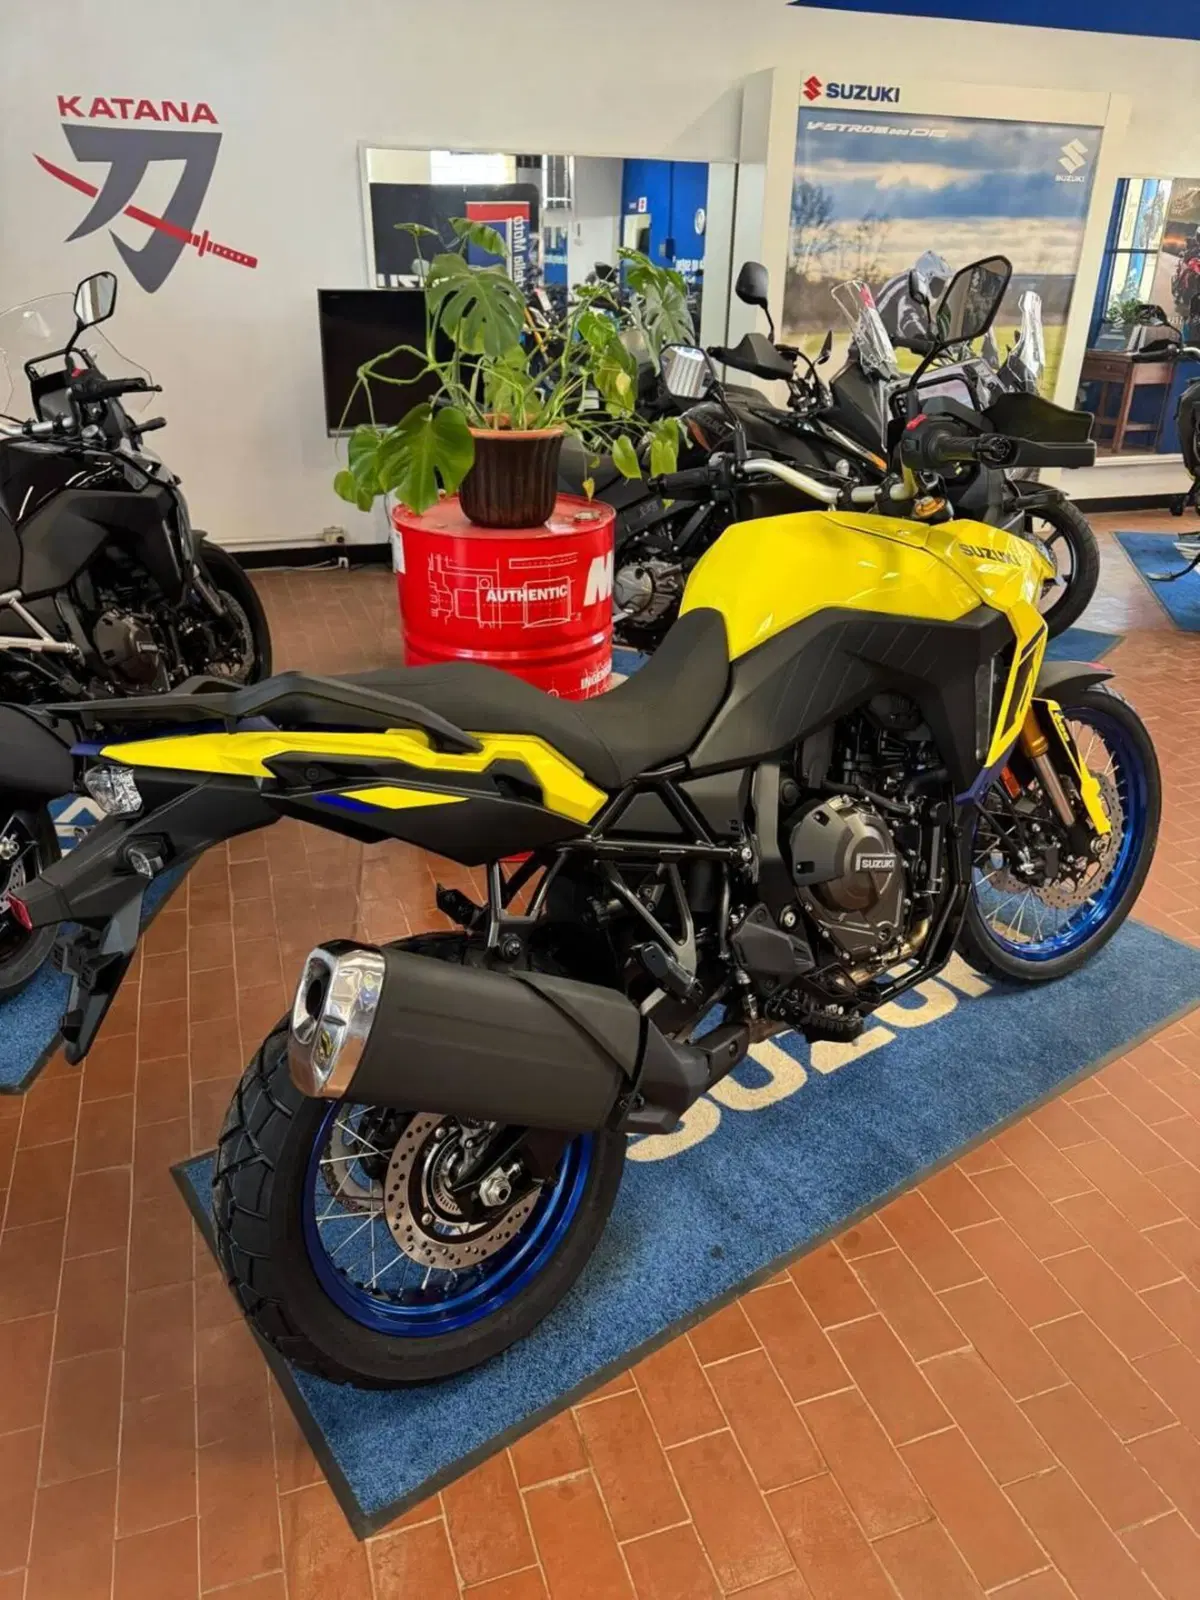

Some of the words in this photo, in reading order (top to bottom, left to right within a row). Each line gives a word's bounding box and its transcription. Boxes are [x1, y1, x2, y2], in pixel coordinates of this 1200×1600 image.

[826, 82, 901, 103] SUZUKI
[57, 95, 219, 124] KATANA
[959, 543, 1021, 567] SUZUKI
[486, 584, 568, 603] AUTHENTIC
[861, 858, 895, 869] SUZUKI
